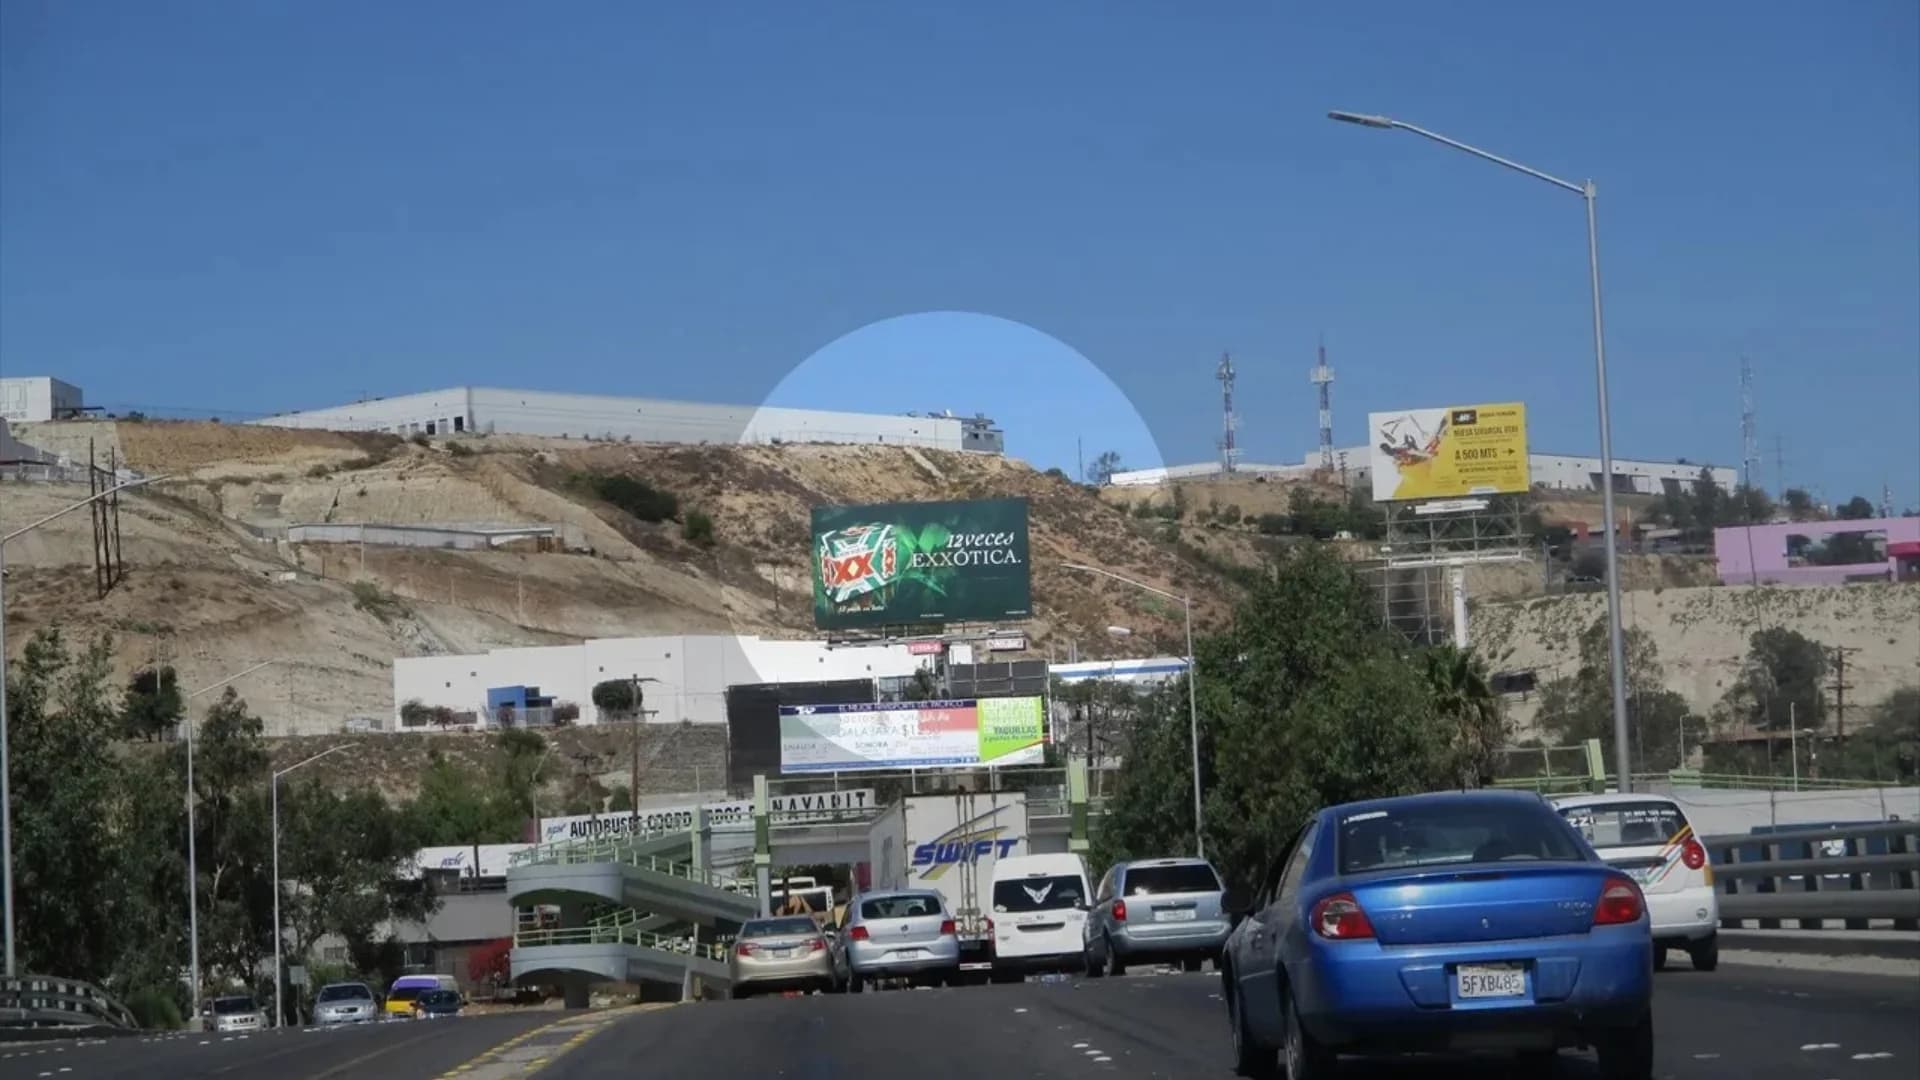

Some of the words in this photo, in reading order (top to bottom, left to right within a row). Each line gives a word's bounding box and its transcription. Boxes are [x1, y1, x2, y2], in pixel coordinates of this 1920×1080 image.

[1455, 449, 1461, 460] A
[1462, 448, 1478, 460] 500
[1480, 447, 1498, 458] MTS
[911, 839, 1019, 866] SWIFT
[1462, 974, 1521, 995] 5FXB485
